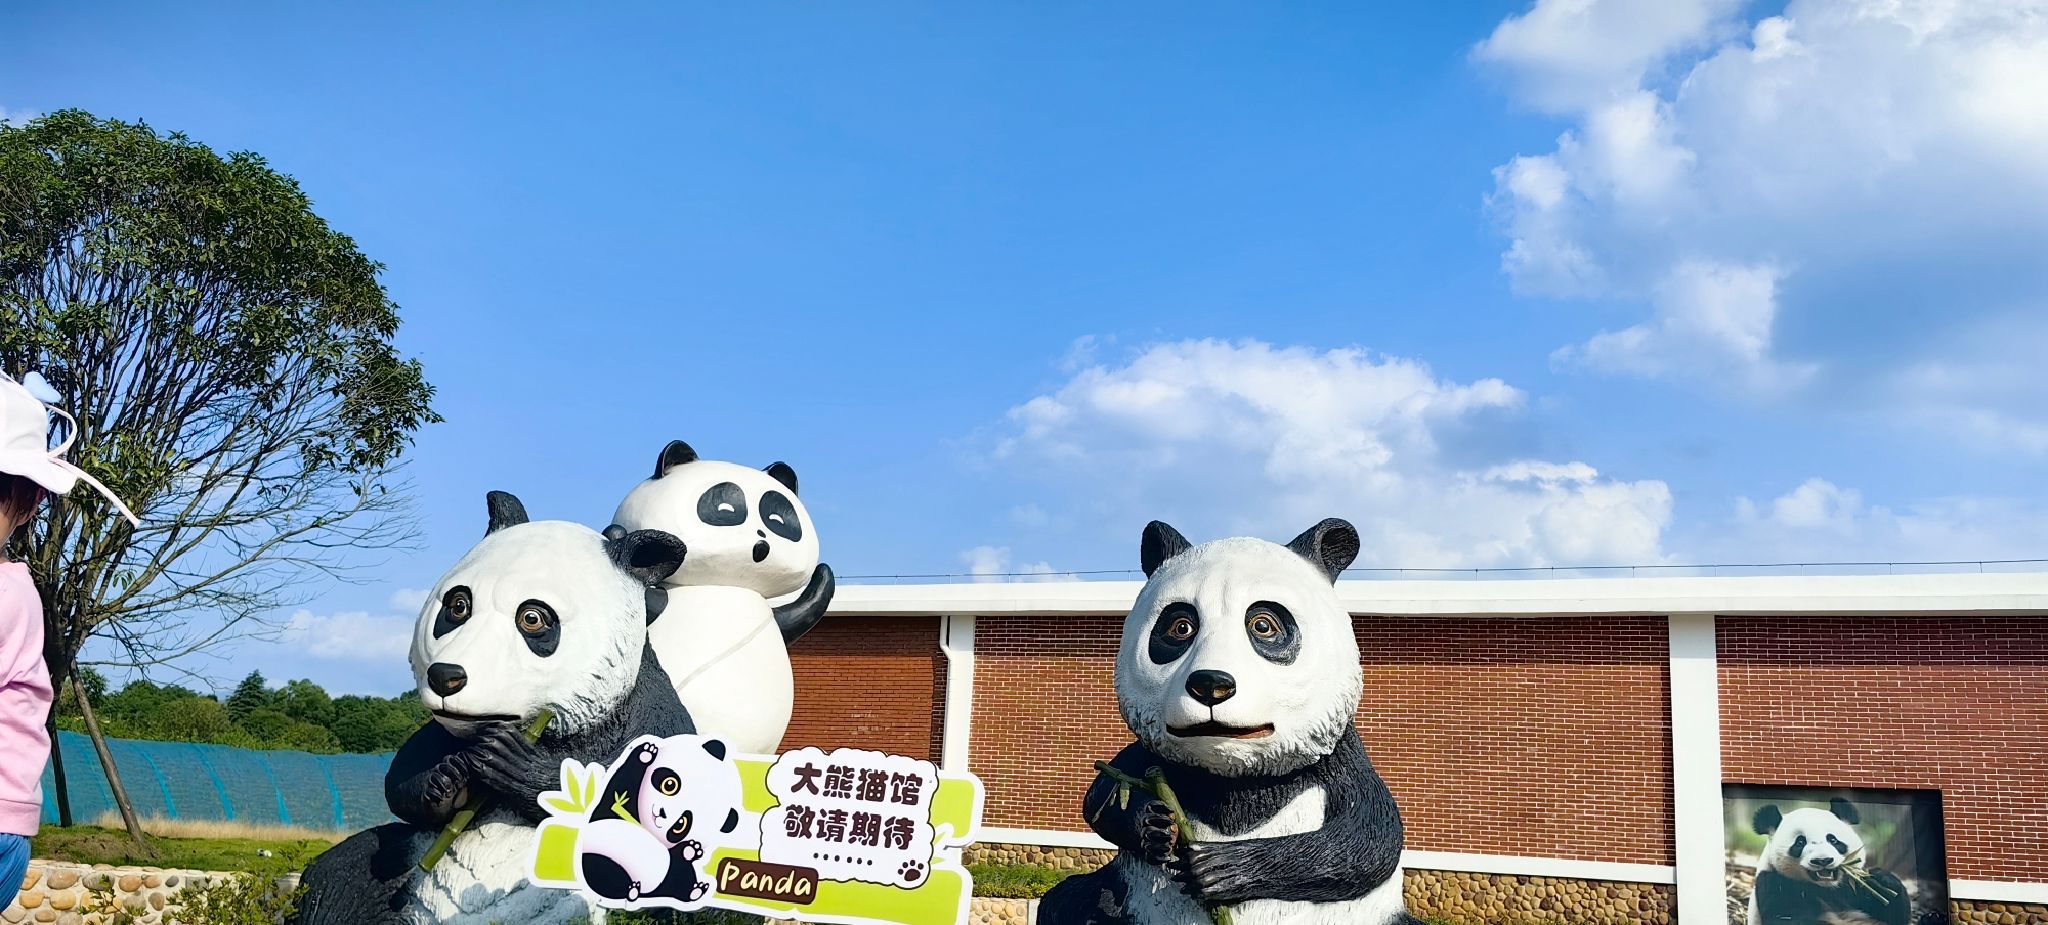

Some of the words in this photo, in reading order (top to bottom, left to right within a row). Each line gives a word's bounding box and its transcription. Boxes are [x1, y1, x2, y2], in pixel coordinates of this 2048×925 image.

[790, 762, 923, 805] 大熊猫馆
[783, 804, 915, 850] 敬请期待
